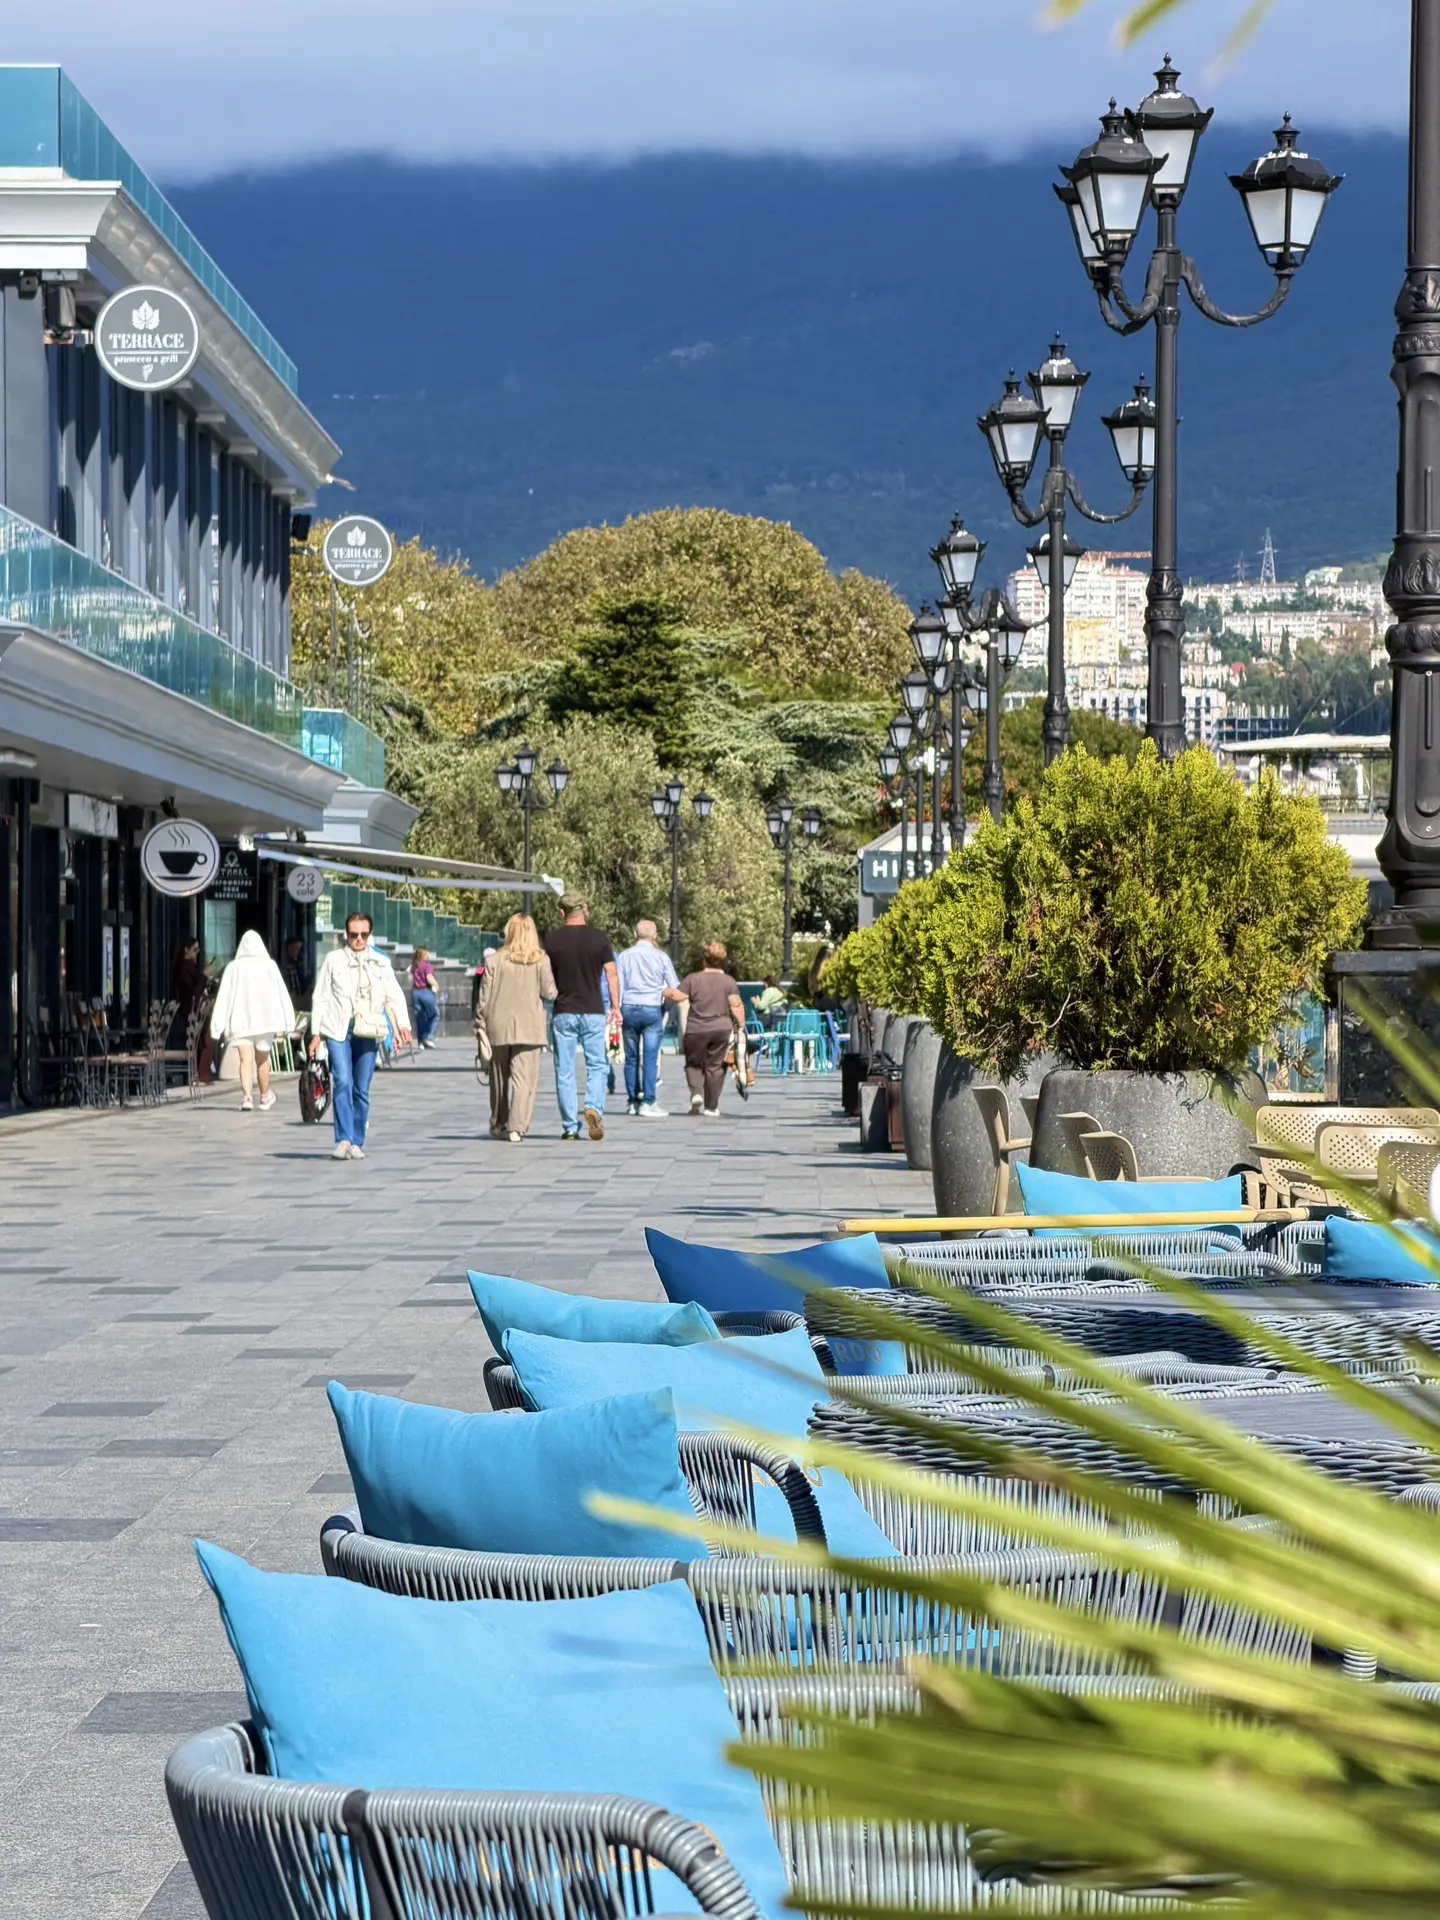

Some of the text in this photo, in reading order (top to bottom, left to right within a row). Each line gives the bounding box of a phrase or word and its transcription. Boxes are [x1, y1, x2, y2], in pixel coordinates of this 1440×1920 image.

[108, 333, 184, 349] TERRACE
[331, 547, 382, 559] TERRACE
[296, 872, 315, 887] 23
